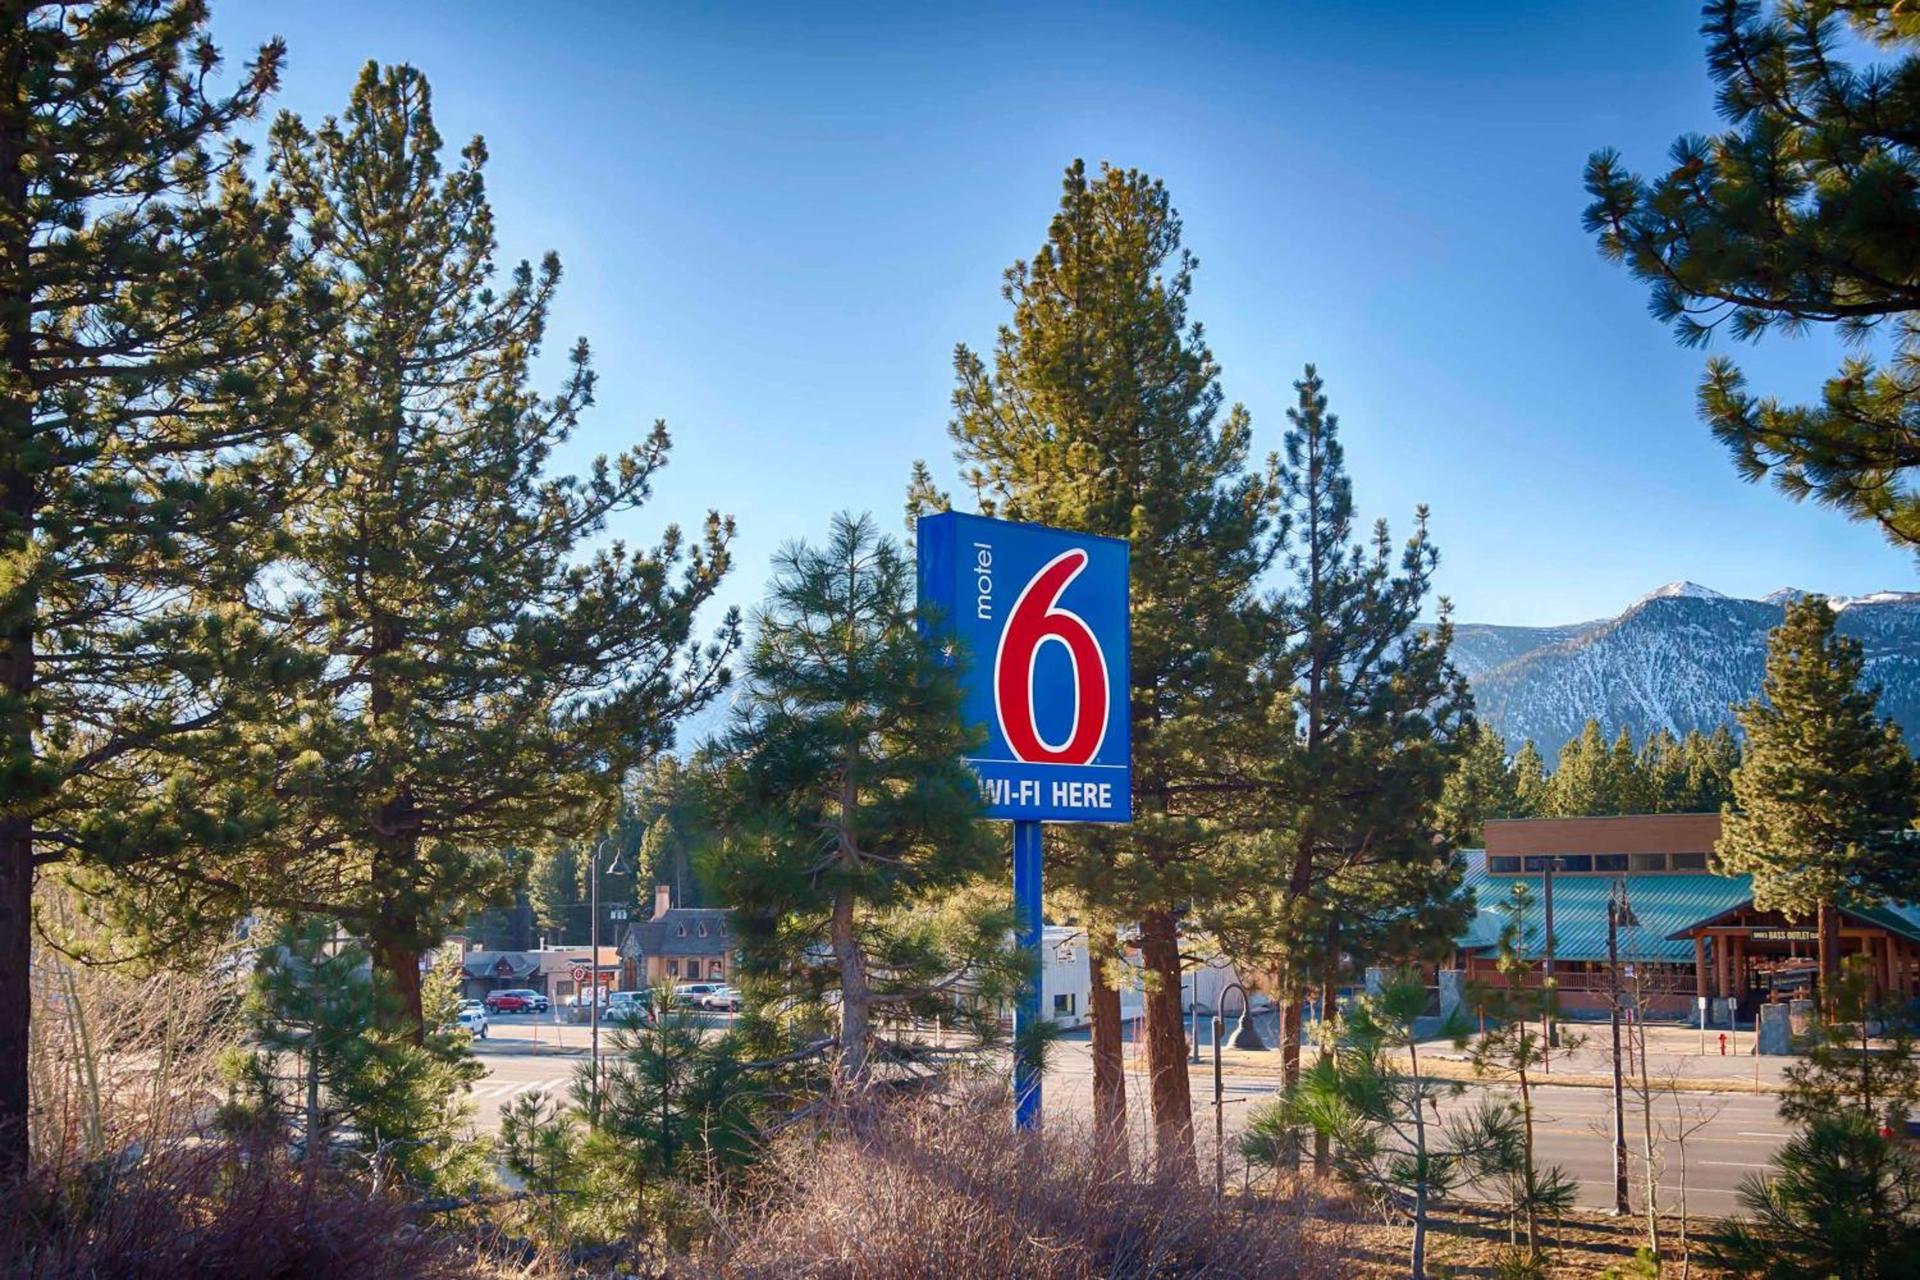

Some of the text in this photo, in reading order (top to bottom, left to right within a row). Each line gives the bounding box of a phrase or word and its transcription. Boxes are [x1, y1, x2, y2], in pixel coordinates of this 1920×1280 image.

[973, 542, 992, 619] motel
[994, 548, 1110, 765] 6
[979, 778, 1112, 808] WI-FI HERE
